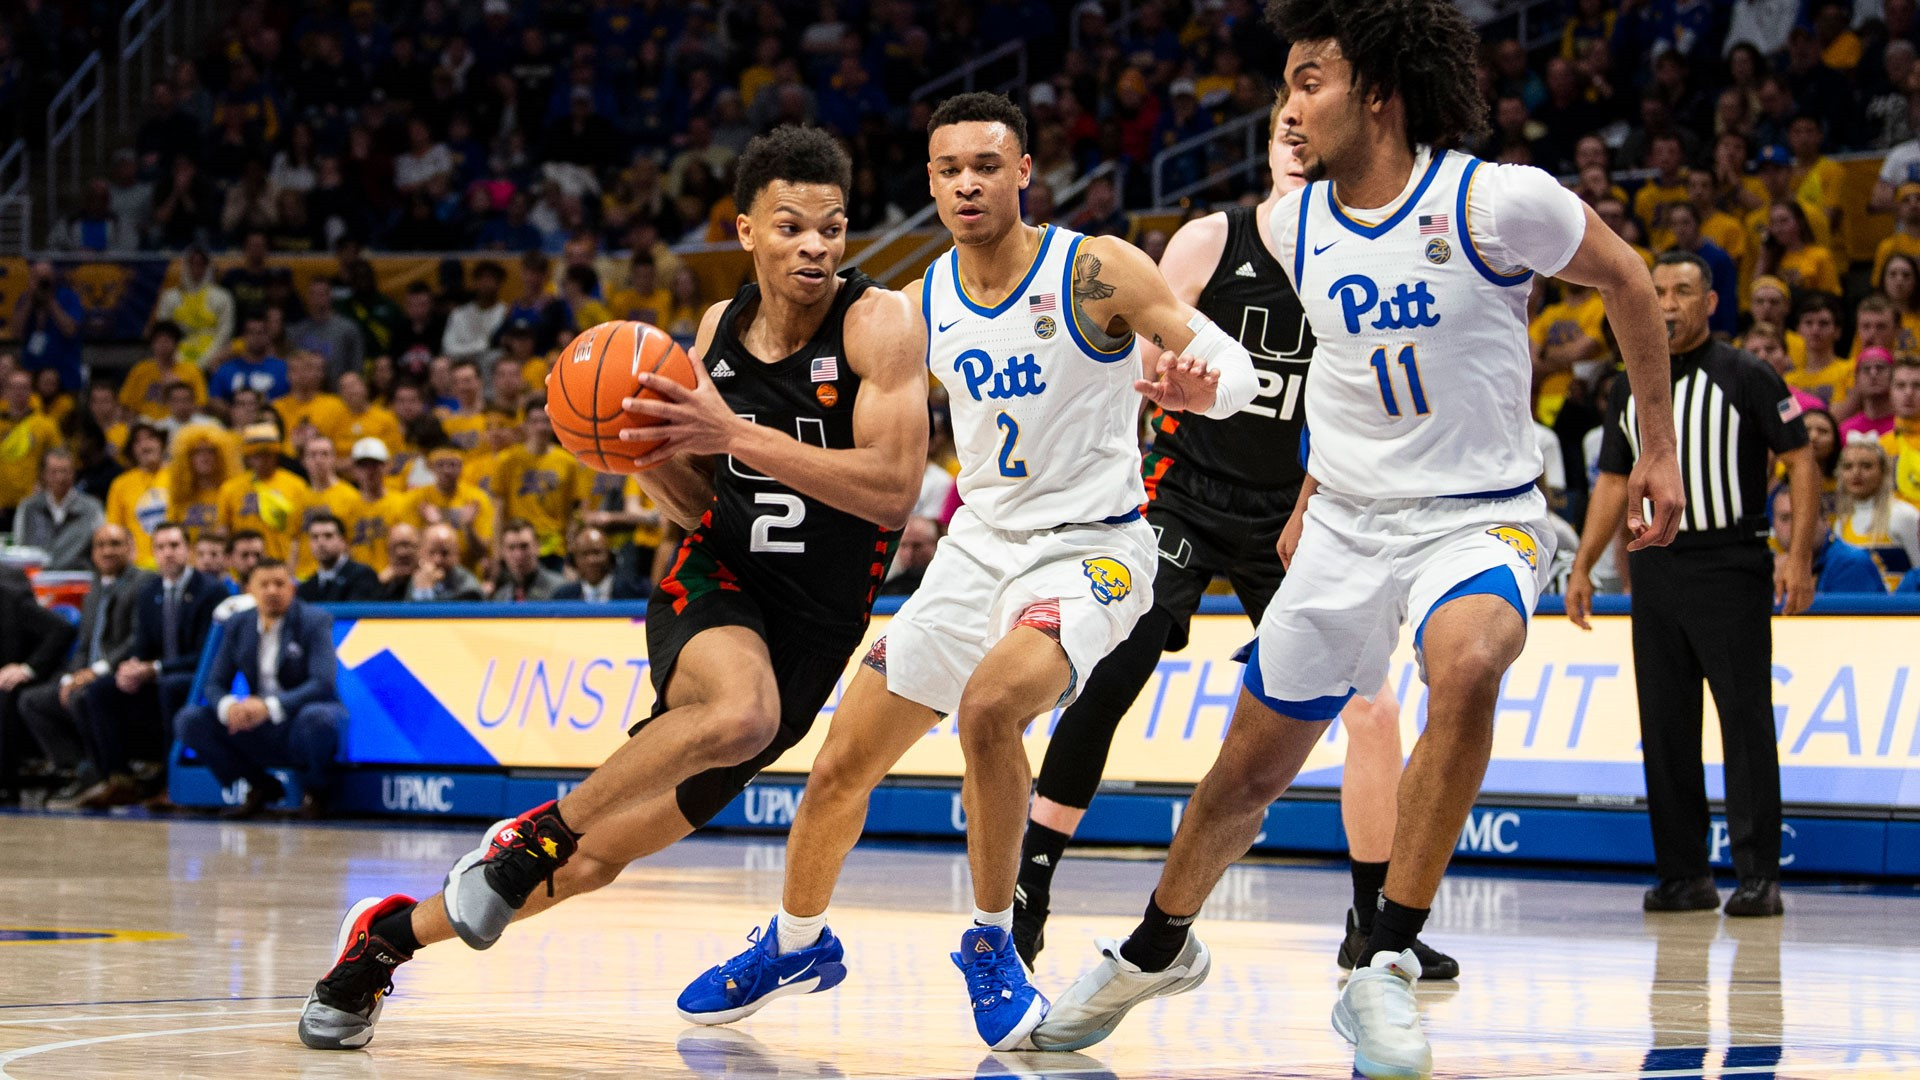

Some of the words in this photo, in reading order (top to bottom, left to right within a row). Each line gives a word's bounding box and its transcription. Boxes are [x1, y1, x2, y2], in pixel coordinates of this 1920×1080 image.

[1328, 274, 1441, 334] Pitt
[954, 349, 1046, 401] Pitt
[1239, 368, 1302, 421] 21
[1369, 342, 1432, 417] 11
[994, 409, 1030, 479] 2
[750, 492, 806, 553] 2
[476, 657, 650, 731] UNST
[1144, 660, 1248, 740] TH
[381, 775, 454, 812] UPMC
[743, 786, 805, 825] UPM
[1455, 811, 1521, 853] MC
